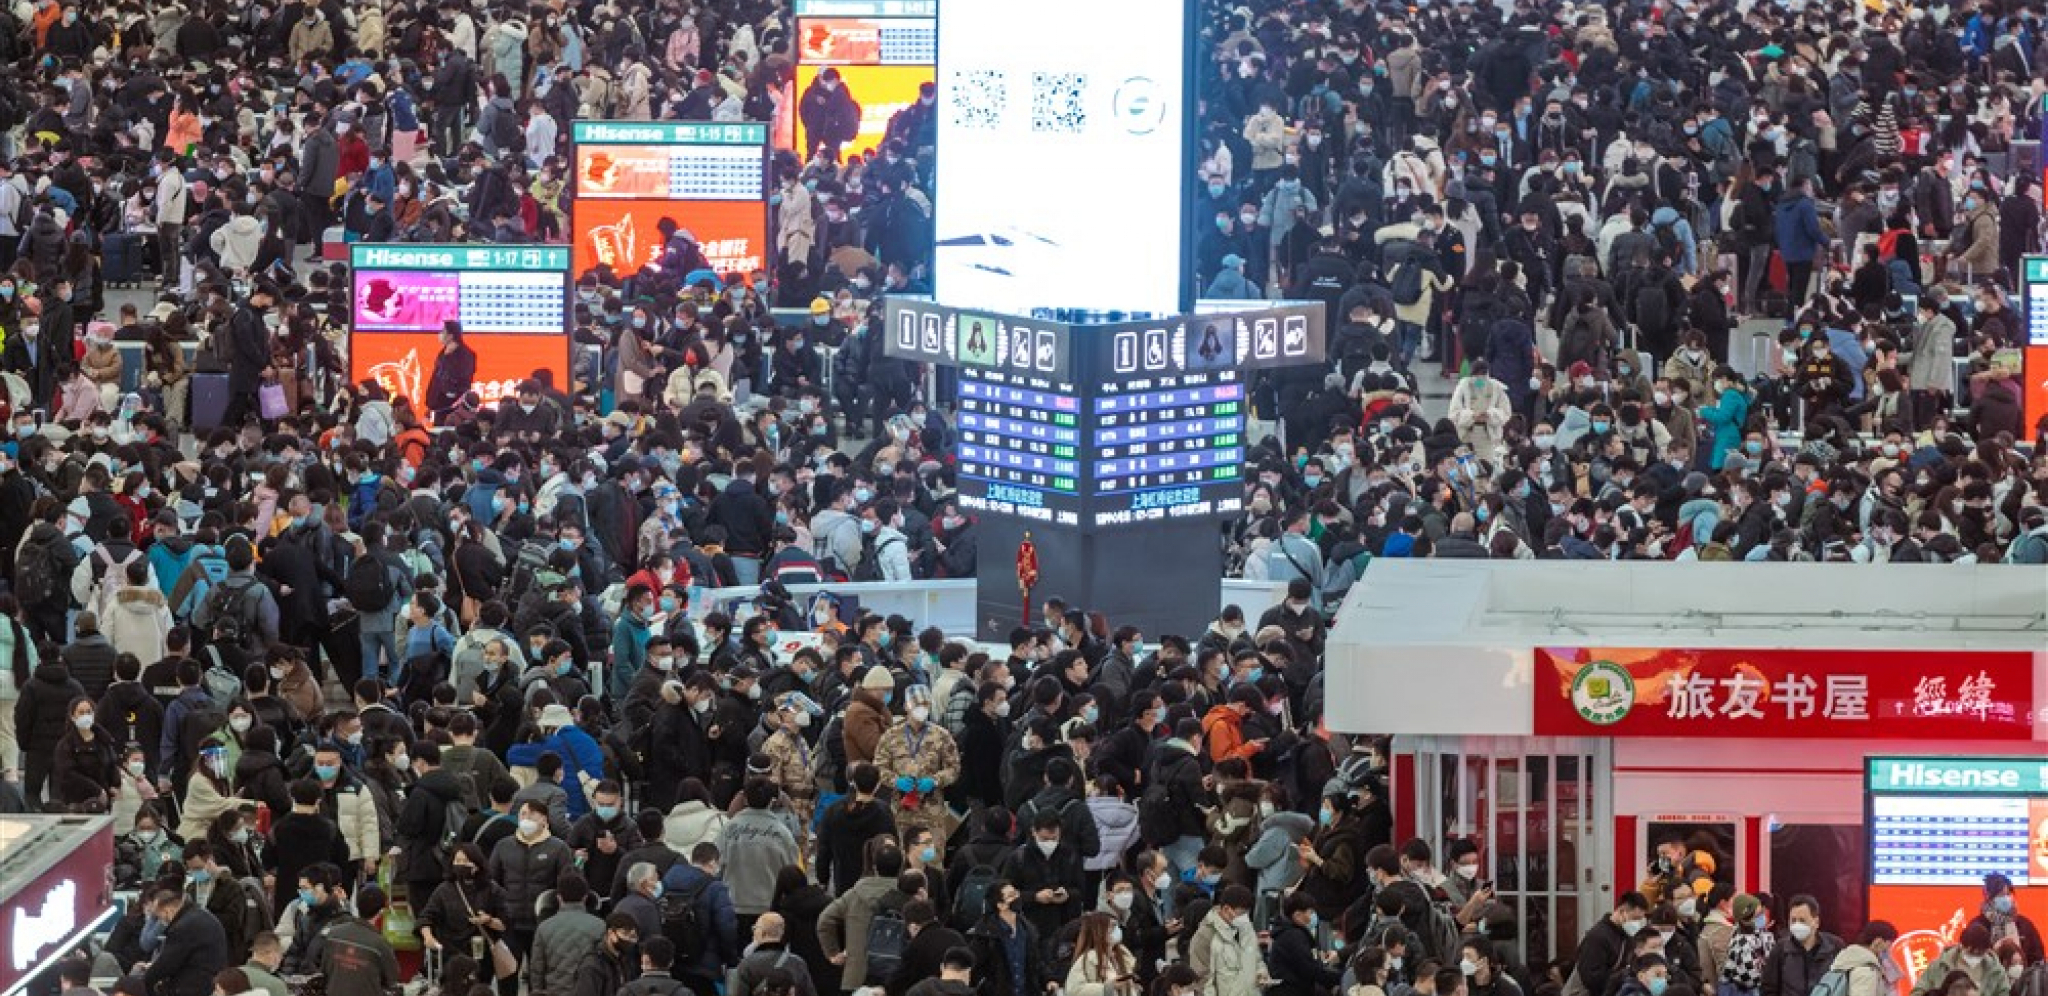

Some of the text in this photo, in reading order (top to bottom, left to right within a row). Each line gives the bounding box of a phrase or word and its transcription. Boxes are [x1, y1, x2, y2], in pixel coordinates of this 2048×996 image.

[585, 125, 664, 140] Hisense
[366, 249, 453, 265] Hisense
[1666, 672, 1869, 720] 旅友书屋
[1890, 763, 2020, 787] Hisense
